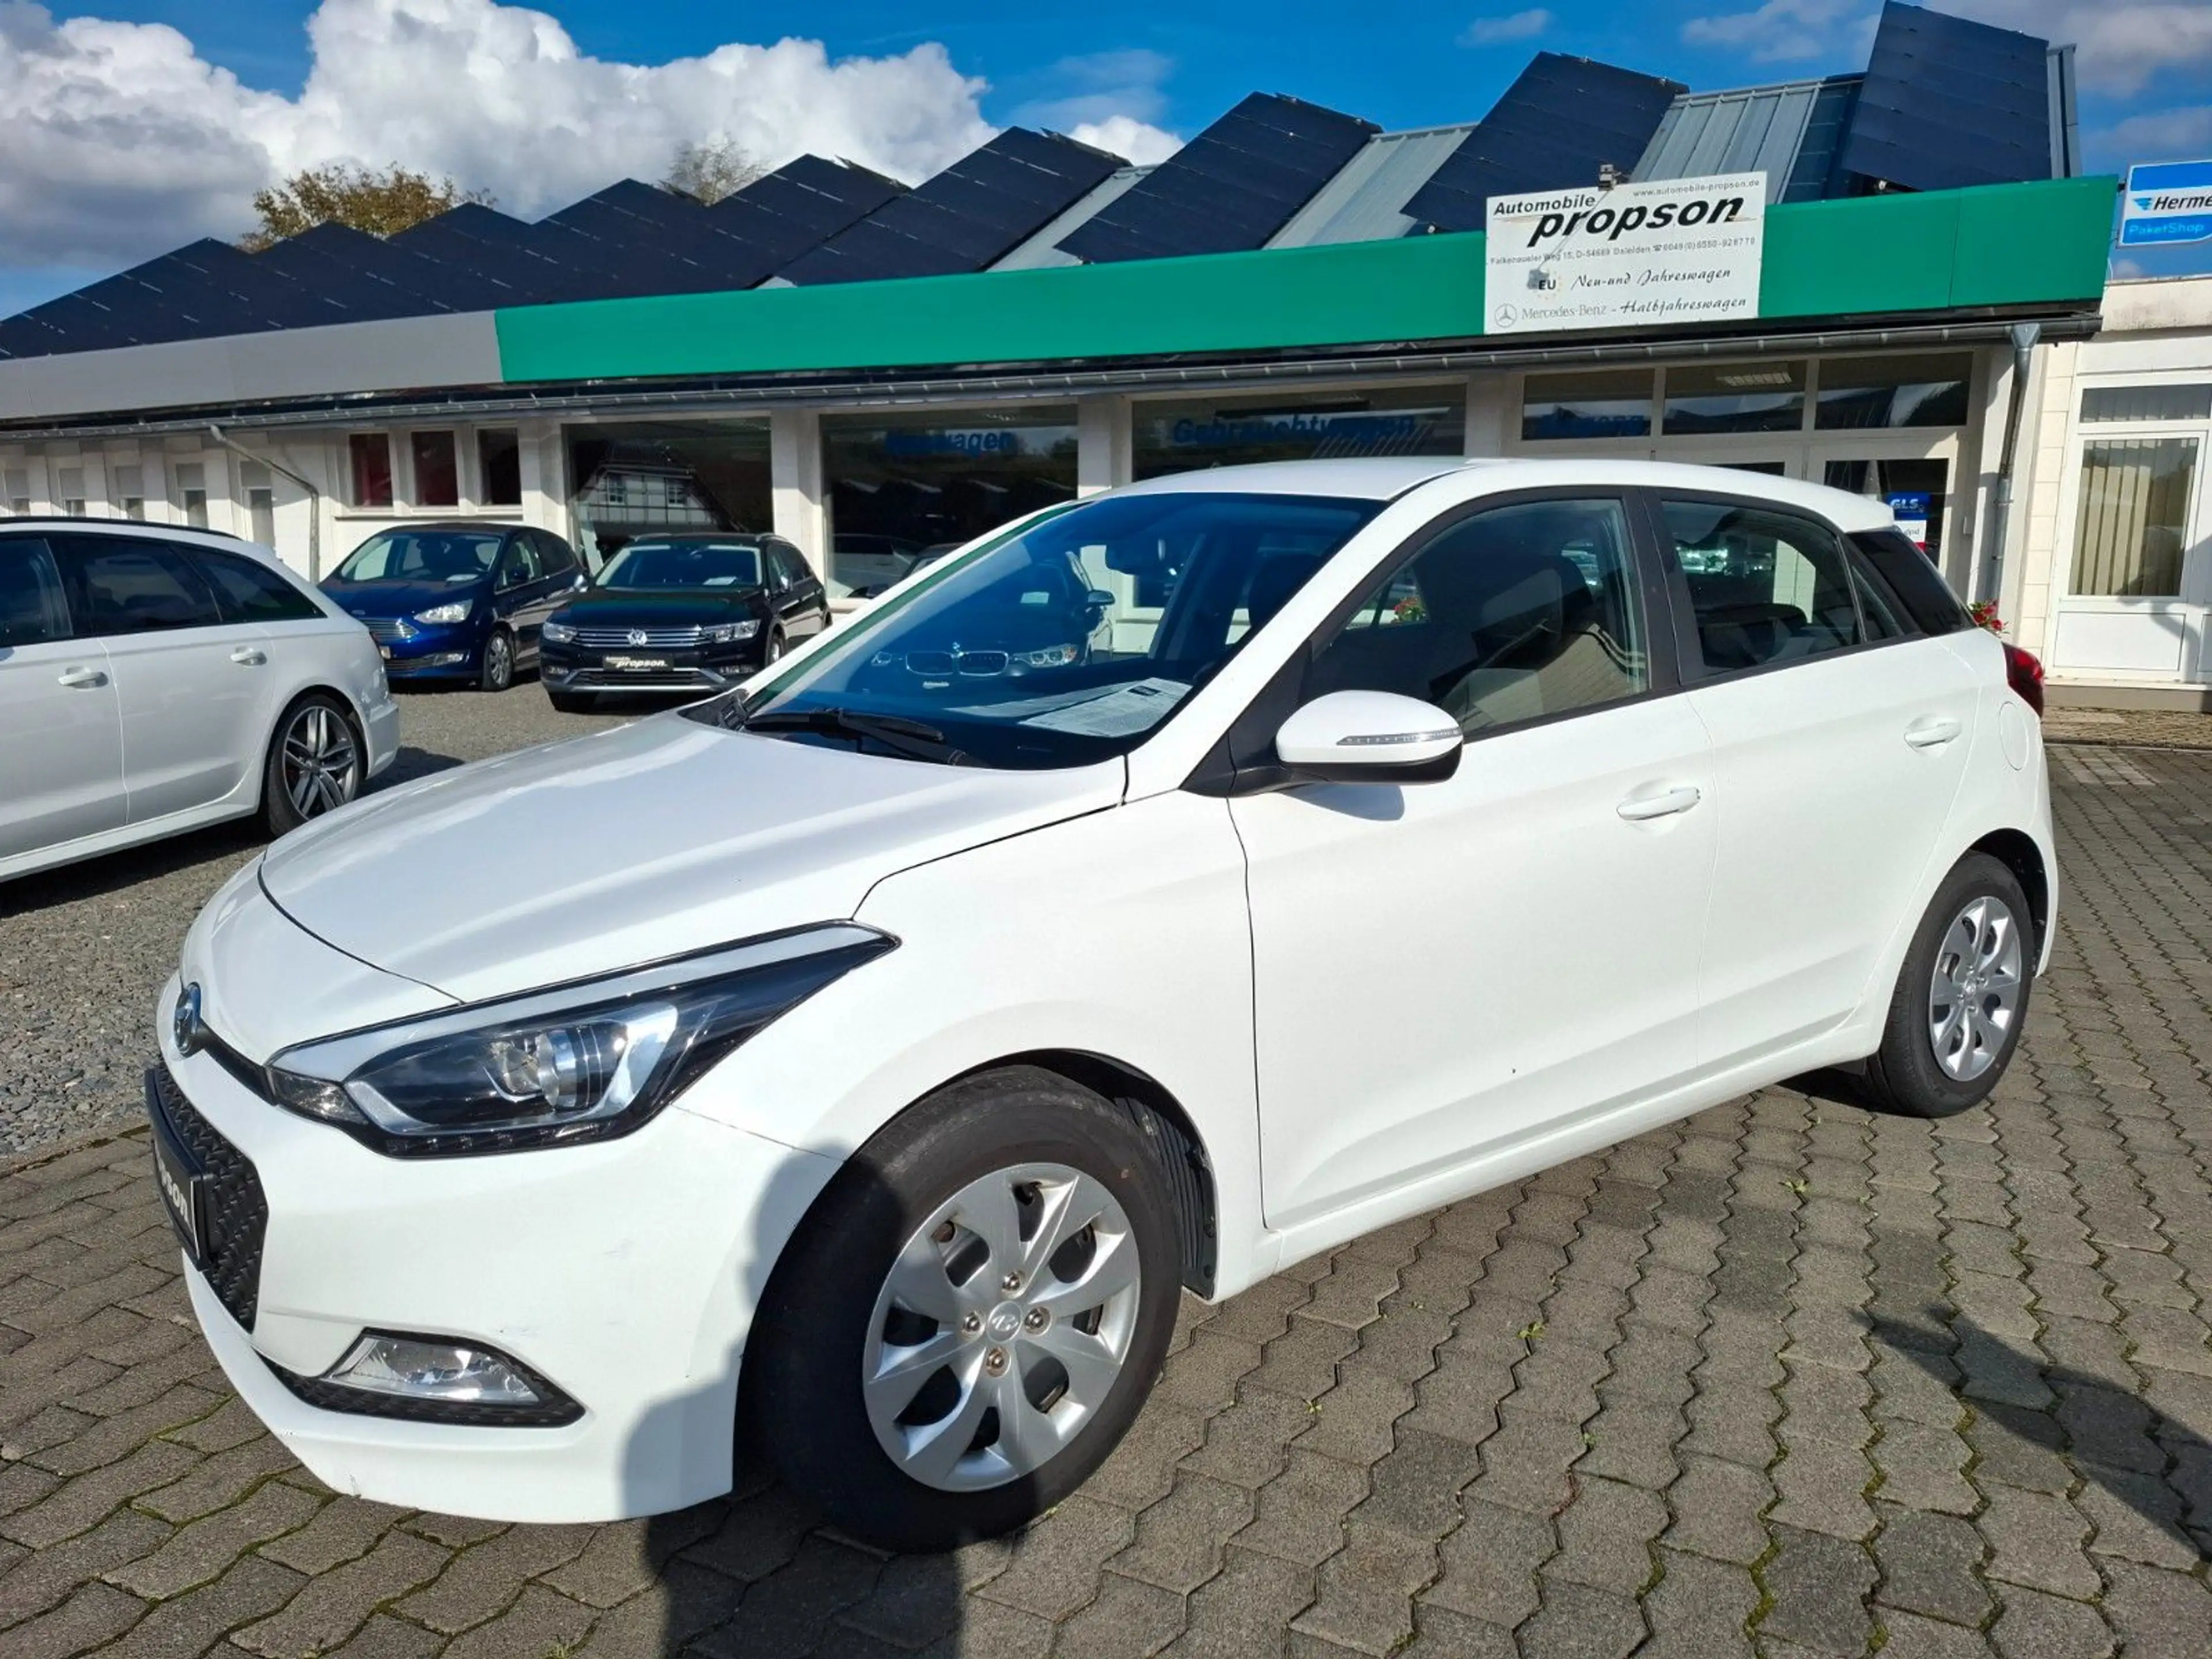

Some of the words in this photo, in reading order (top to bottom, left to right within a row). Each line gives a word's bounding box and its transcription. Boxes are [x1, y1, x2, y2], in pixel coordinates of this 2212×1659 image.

[1633, 179, 1760, 196] www.automobile-propson.de
[1493, 195, 1596, 215] Automobile
[1527, 196, 1744, 247] propson
[2128, 222, 2205, 234] PaketShop
[1539, 279, 1556, 290] EU
[1637, 268, 1731, 286] Jahreswagen
[1521, 304, 1607, 320] Mercedes-Benz
[1620, 297, 1747, 316] Halbjahreswagen
[1890, 498, 1919, 510] GLS
[616, 660, 665, 669] propson
